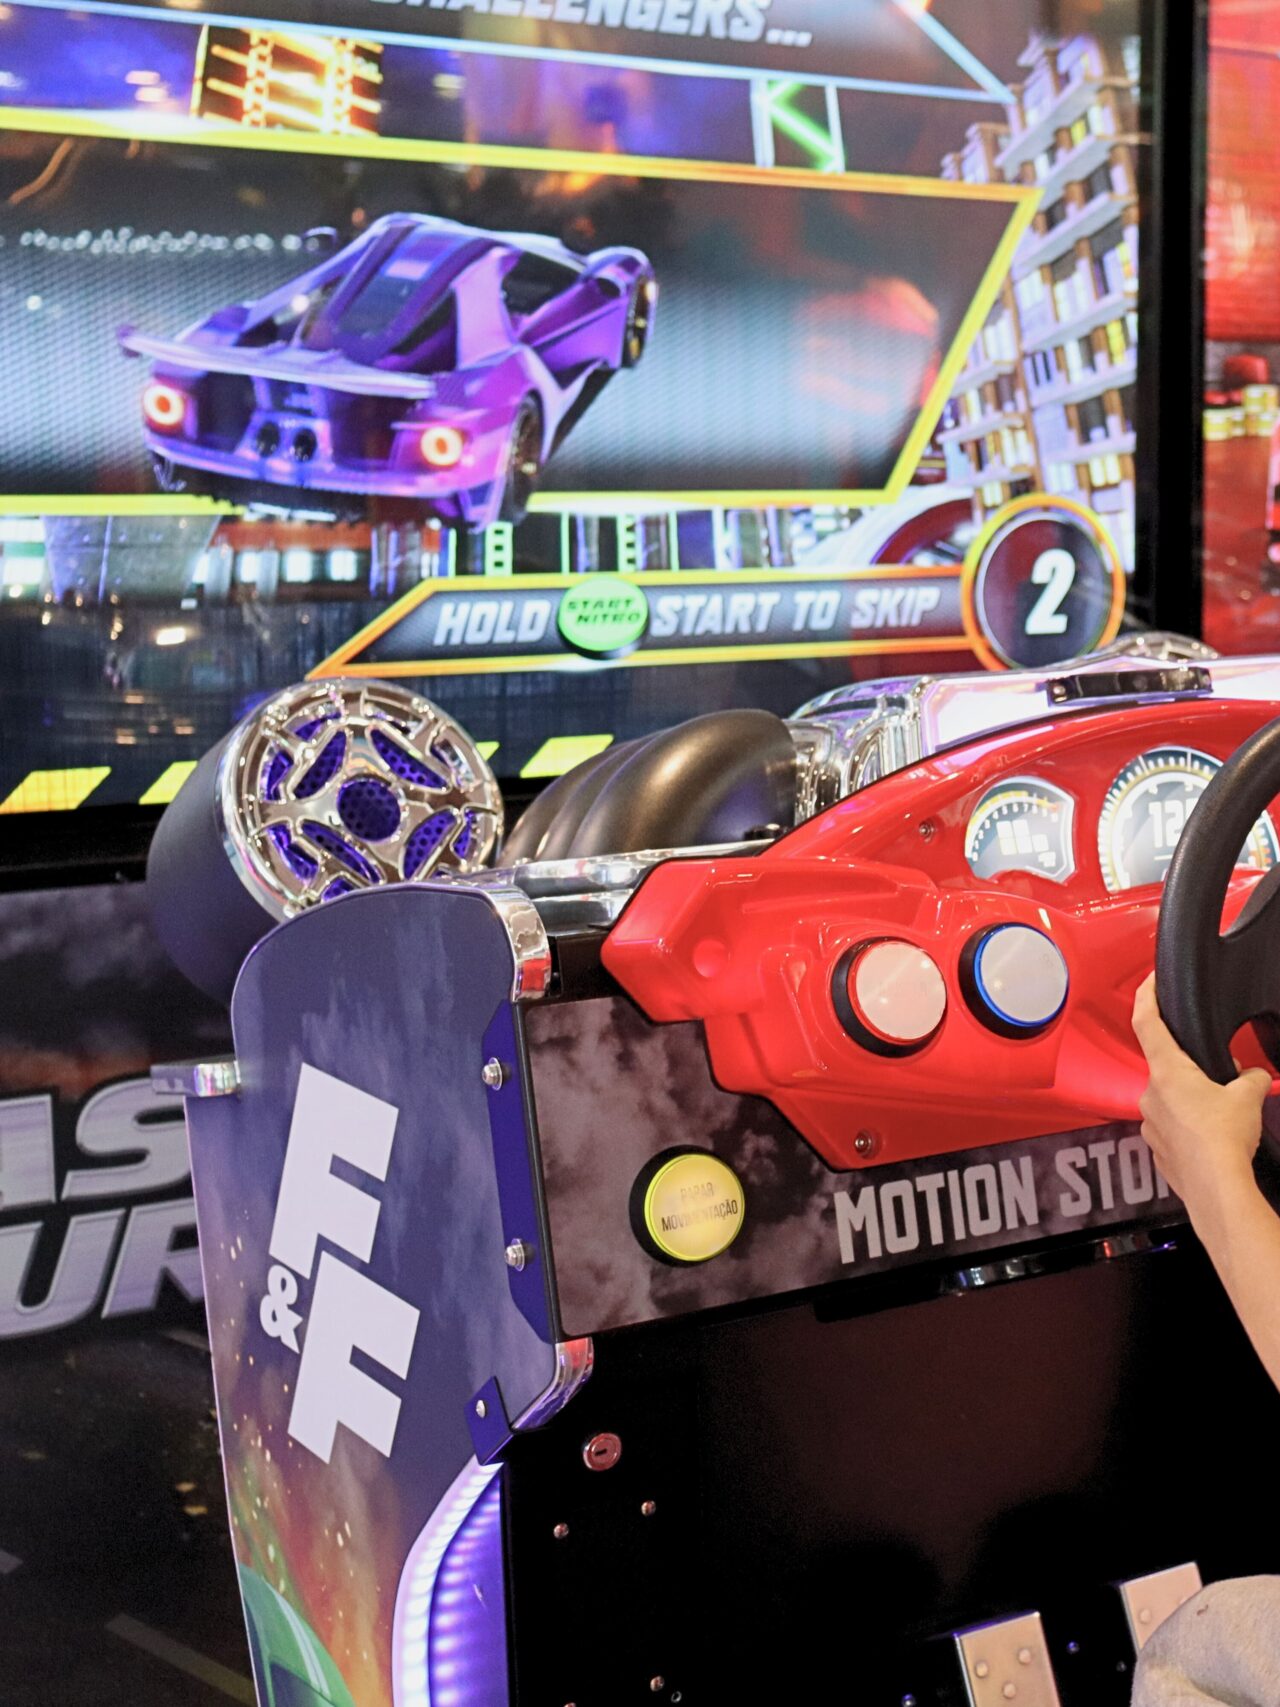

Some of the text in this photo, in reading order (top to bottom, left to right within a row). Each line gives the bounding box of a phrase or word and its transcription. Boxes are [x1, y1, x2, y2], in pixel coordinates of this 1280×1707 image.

[567, 597, 633, 610] START
[649, 586, 941, 638] START TO SKIP
[1024, 548, 1077, 635] 2
[432, 599, 552, 647] HOLD
[577, 611, 641, 624] NITRO
[660, 1198, 739, 1233] MOVINTAÇÃO
[832, 1155, 1040, 1265] MOTION
